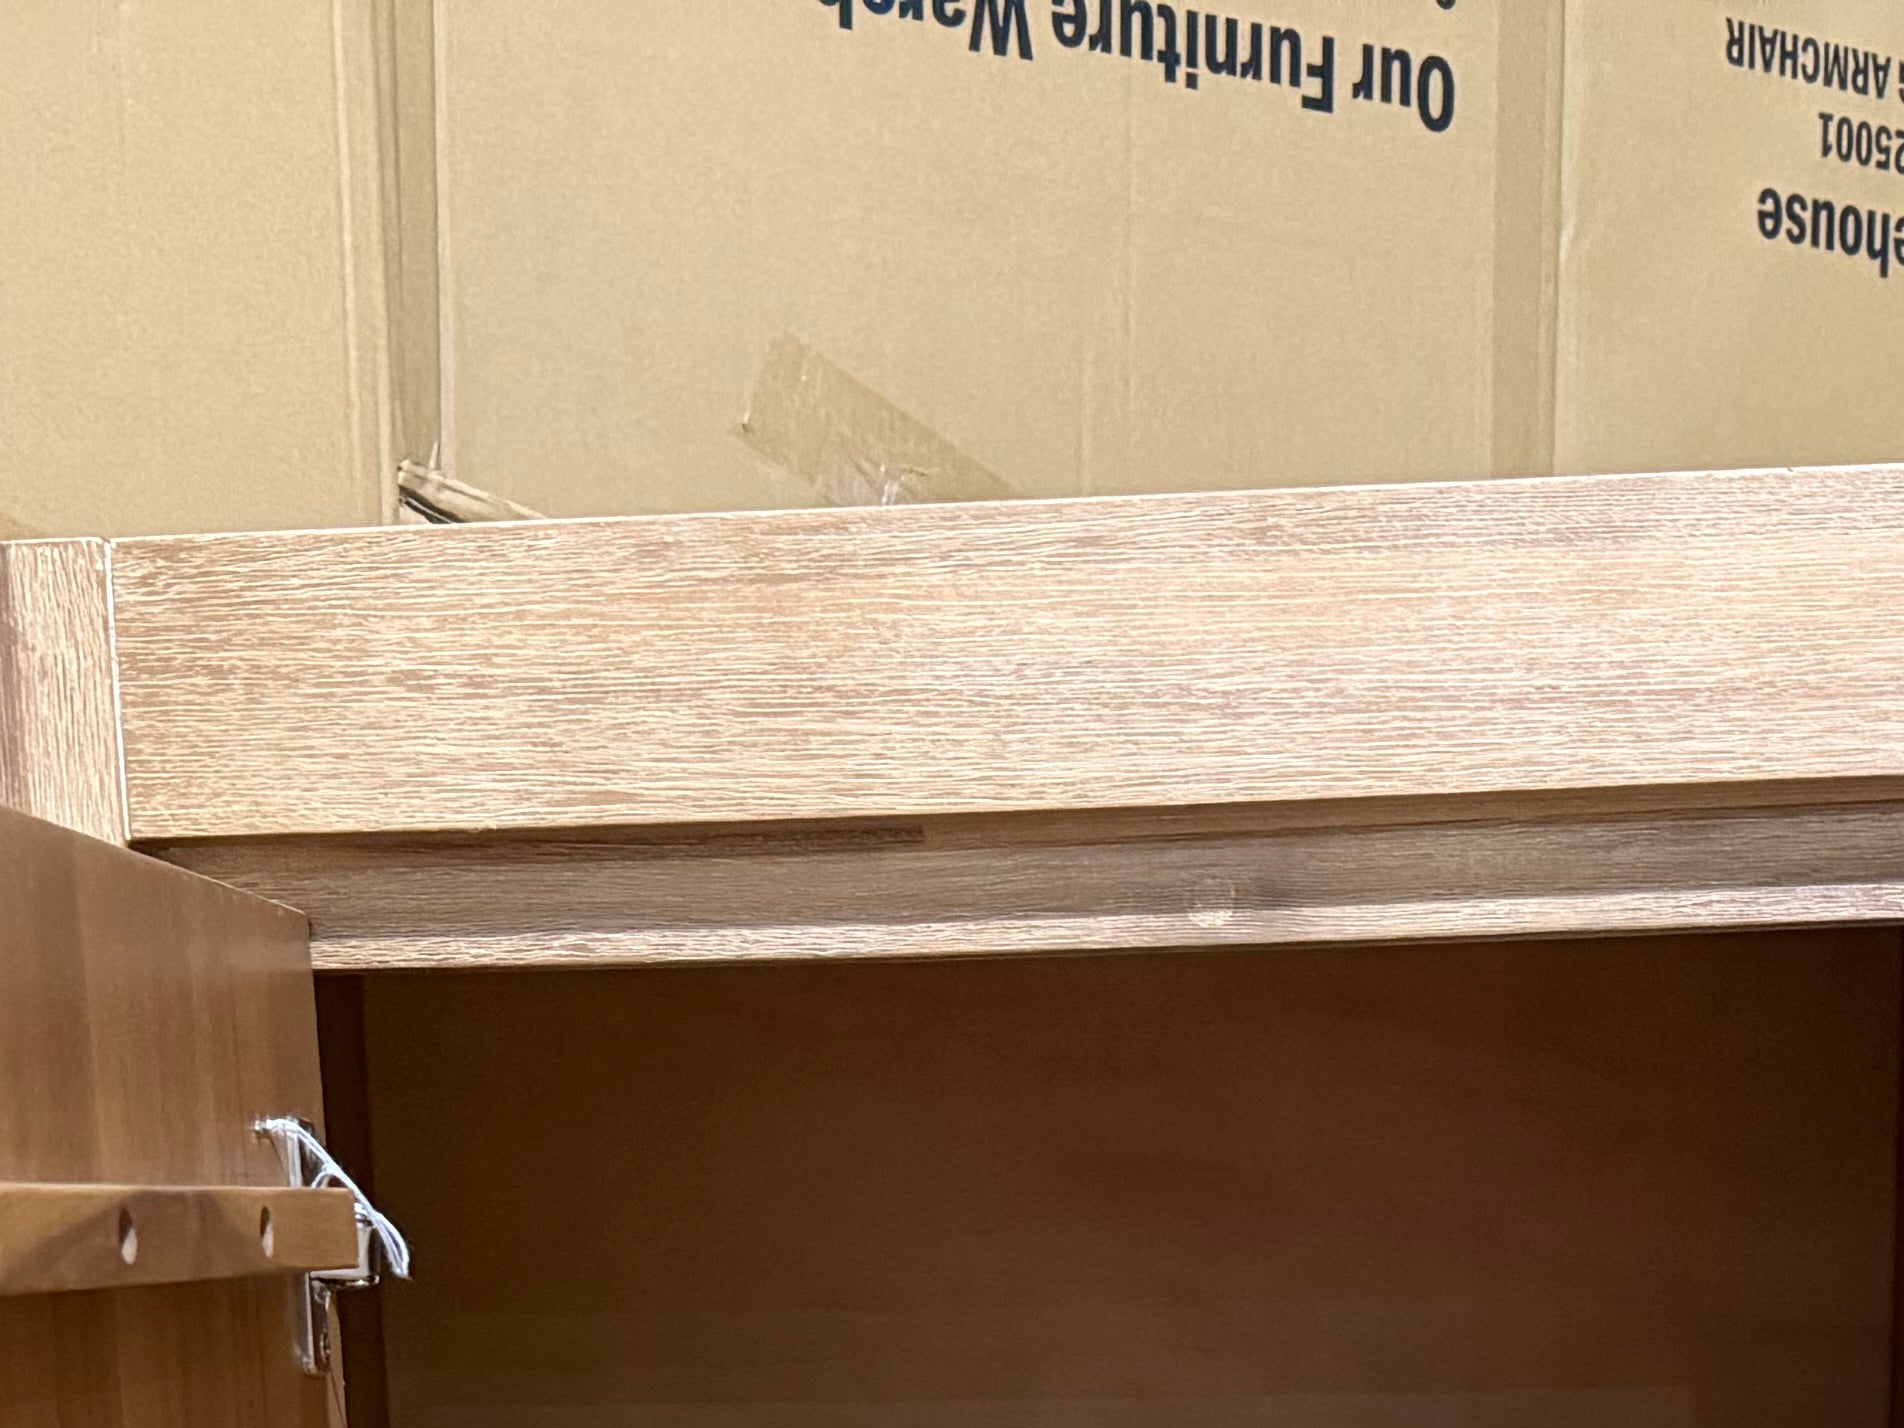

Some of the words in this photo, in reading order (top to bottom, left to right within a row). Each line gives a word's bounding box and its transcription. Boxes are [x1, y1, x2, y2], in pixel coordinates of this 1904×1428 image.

[1051, 0, 1335, 114] Furniture
[1352, 43, 1456, 133] Our
[1725, 17, 1892, 100] ARMCHAIR
